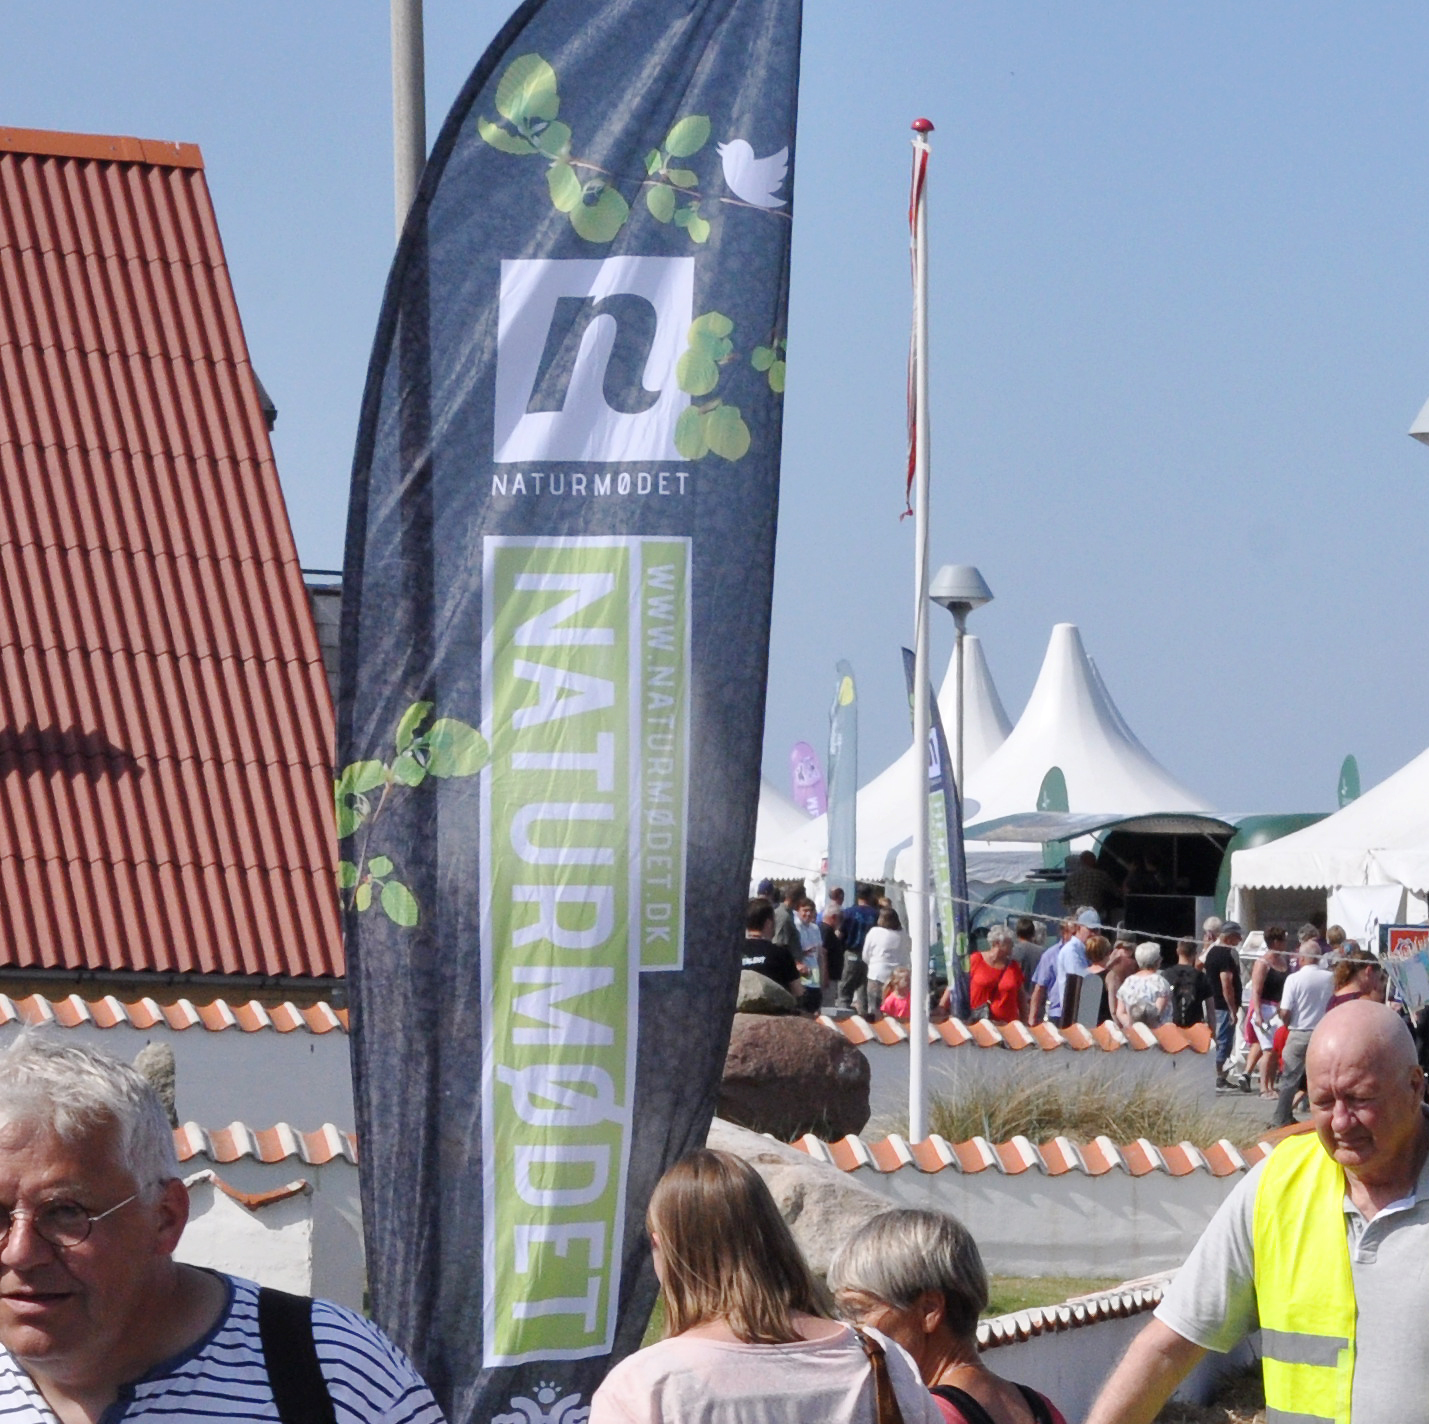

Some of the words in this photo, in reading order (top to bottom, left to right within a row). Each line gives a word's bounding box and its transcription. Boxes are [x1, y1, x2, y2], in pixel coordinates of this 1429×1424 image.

[491, 472, 689, 496] NATURMØDET
[645, 564, 676, 944] WWW.NATURMØDET.DK
[497, 573, 626, 1334] NATURMØDET
